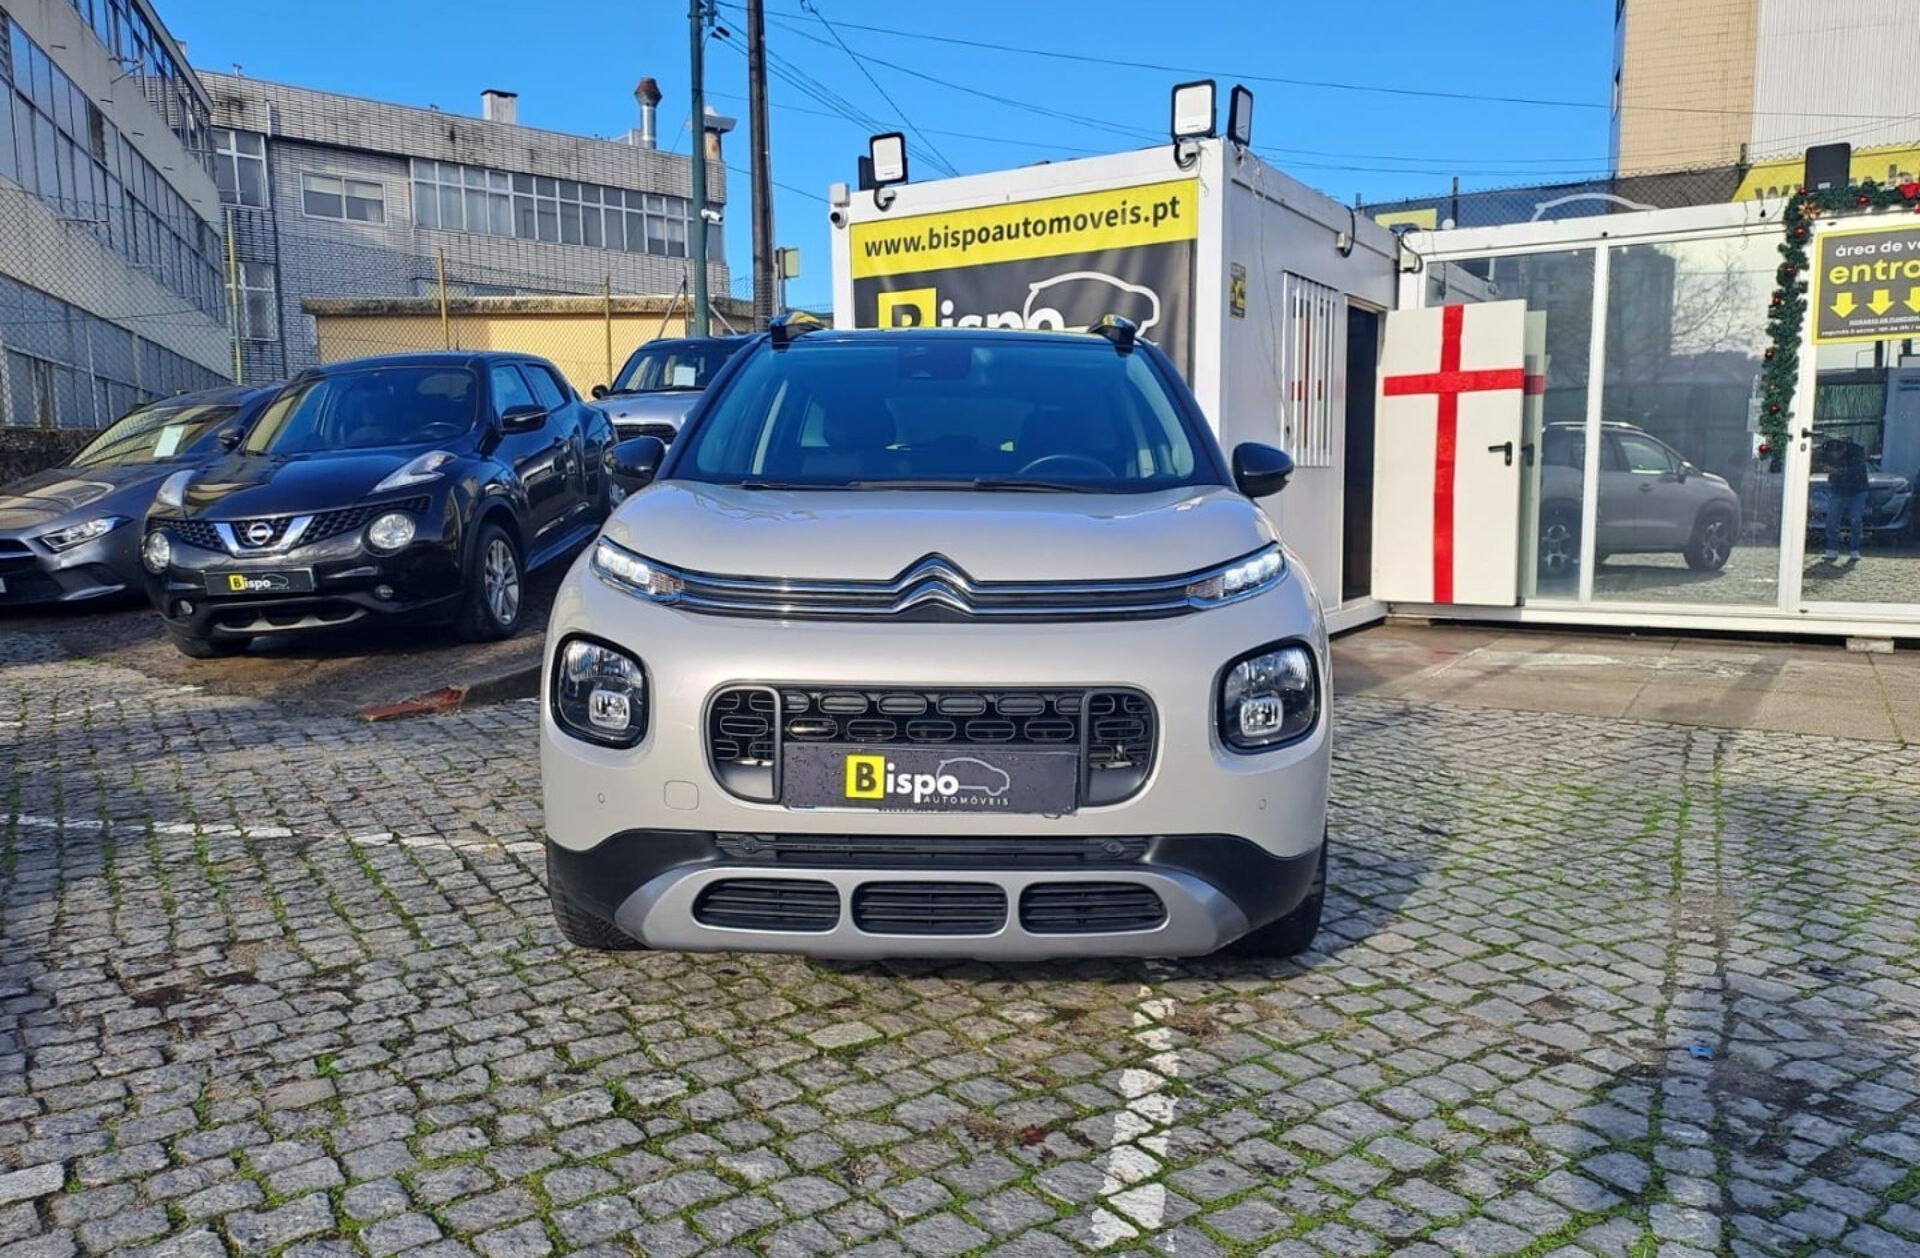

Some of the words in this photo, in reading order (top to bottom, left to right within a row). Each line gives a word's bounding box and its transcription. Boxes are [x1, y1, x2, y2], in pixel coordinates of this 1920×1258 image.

[865, 196, 1180, 257] www.bispoautomoveis.pt
[1835, 244, 1875, 257] área
[1880, 241, 1903, 253] de
[1907, 241, 1920, 250] v
[232, 577, 271, 590] Bispo
[855, 762, 959, 803] Bispo
[922, 795, 1009, 806] AUTOMÓVEIS
